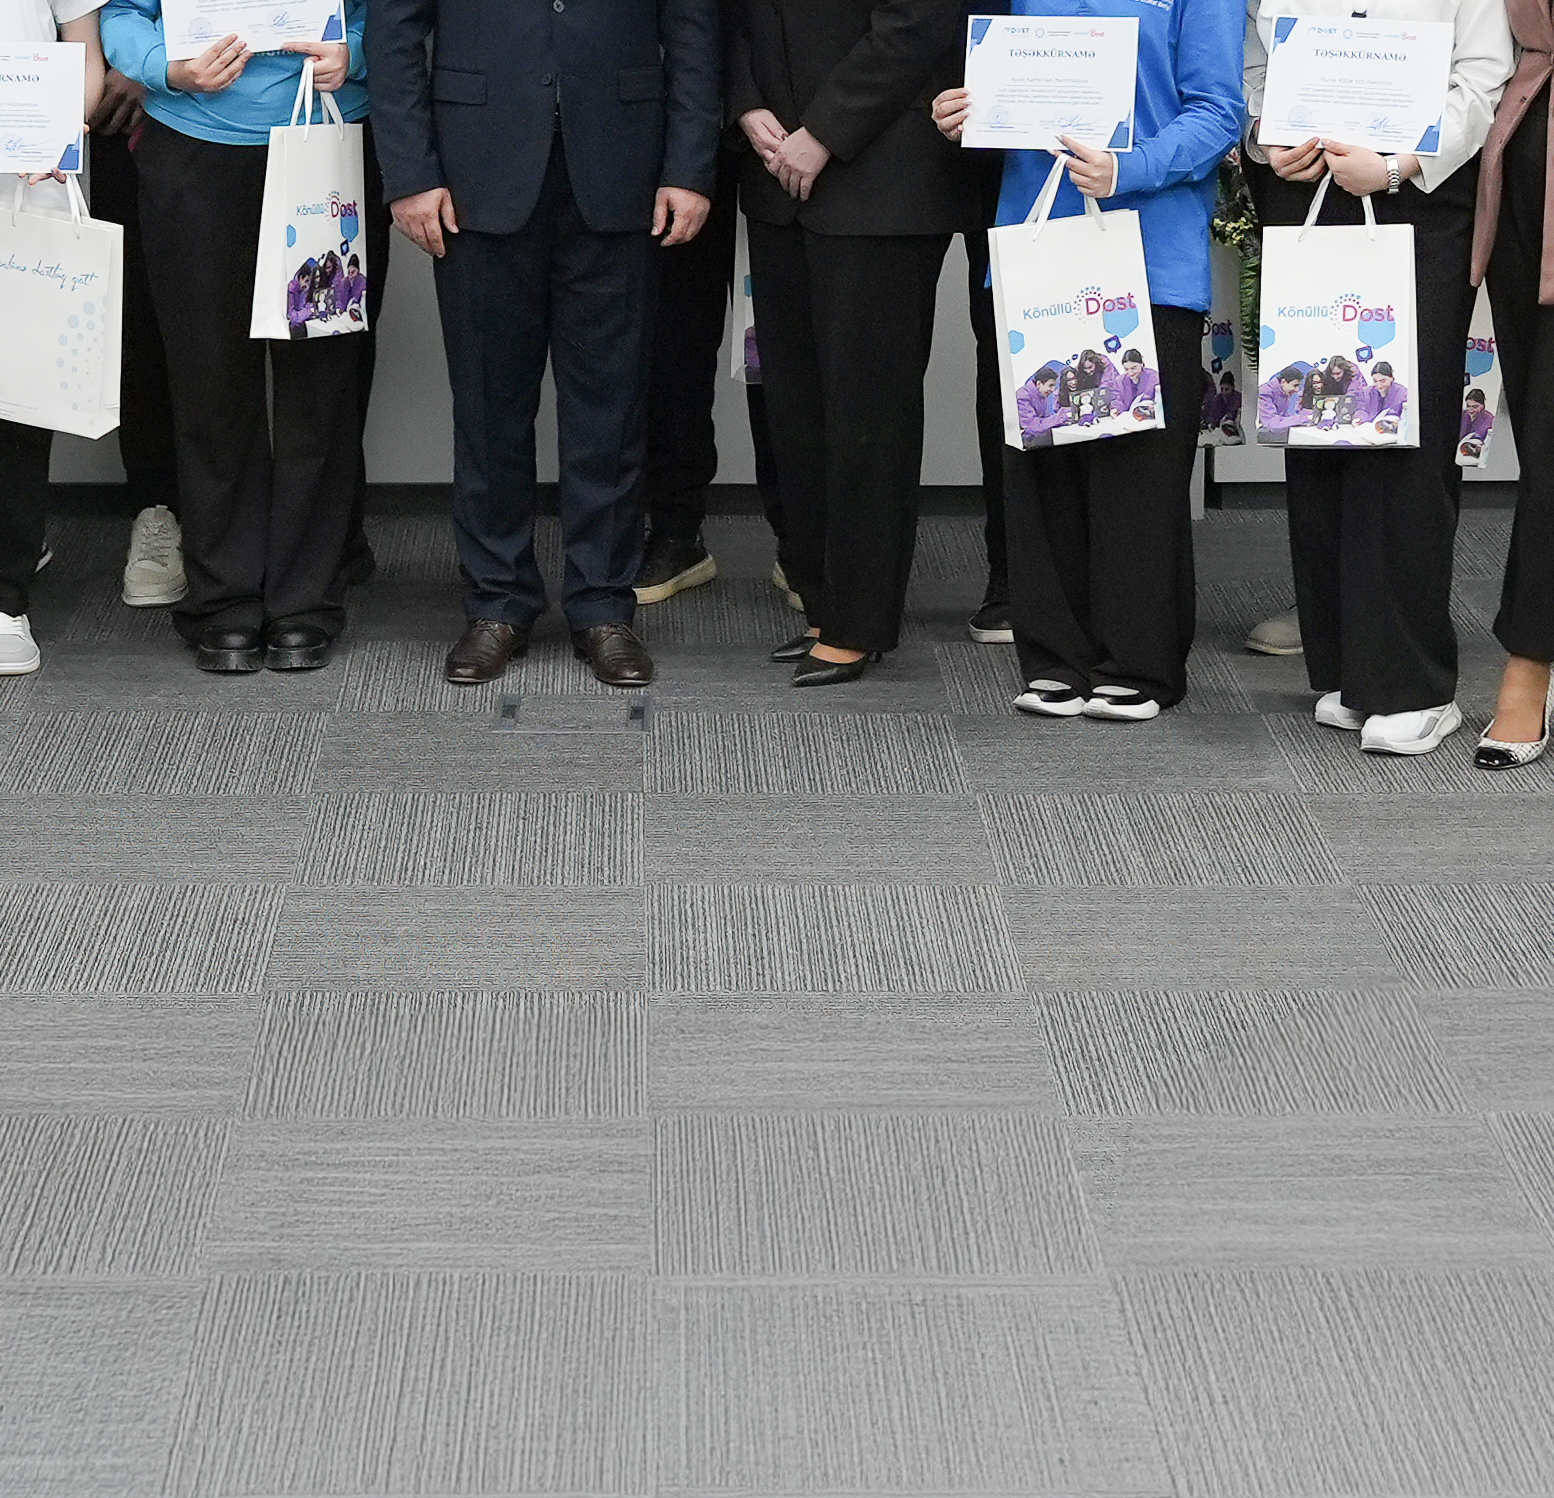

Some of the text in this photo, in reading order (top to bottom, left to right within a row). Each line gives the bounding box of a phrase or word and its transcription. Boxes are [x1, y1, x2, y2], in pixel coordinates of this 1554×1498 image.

[330, 199, 358, 218] Dost
[1023, 292, 1137, 320] Könüllü Dost
[1277, 304, 1395, 322] Könüllü Dost
